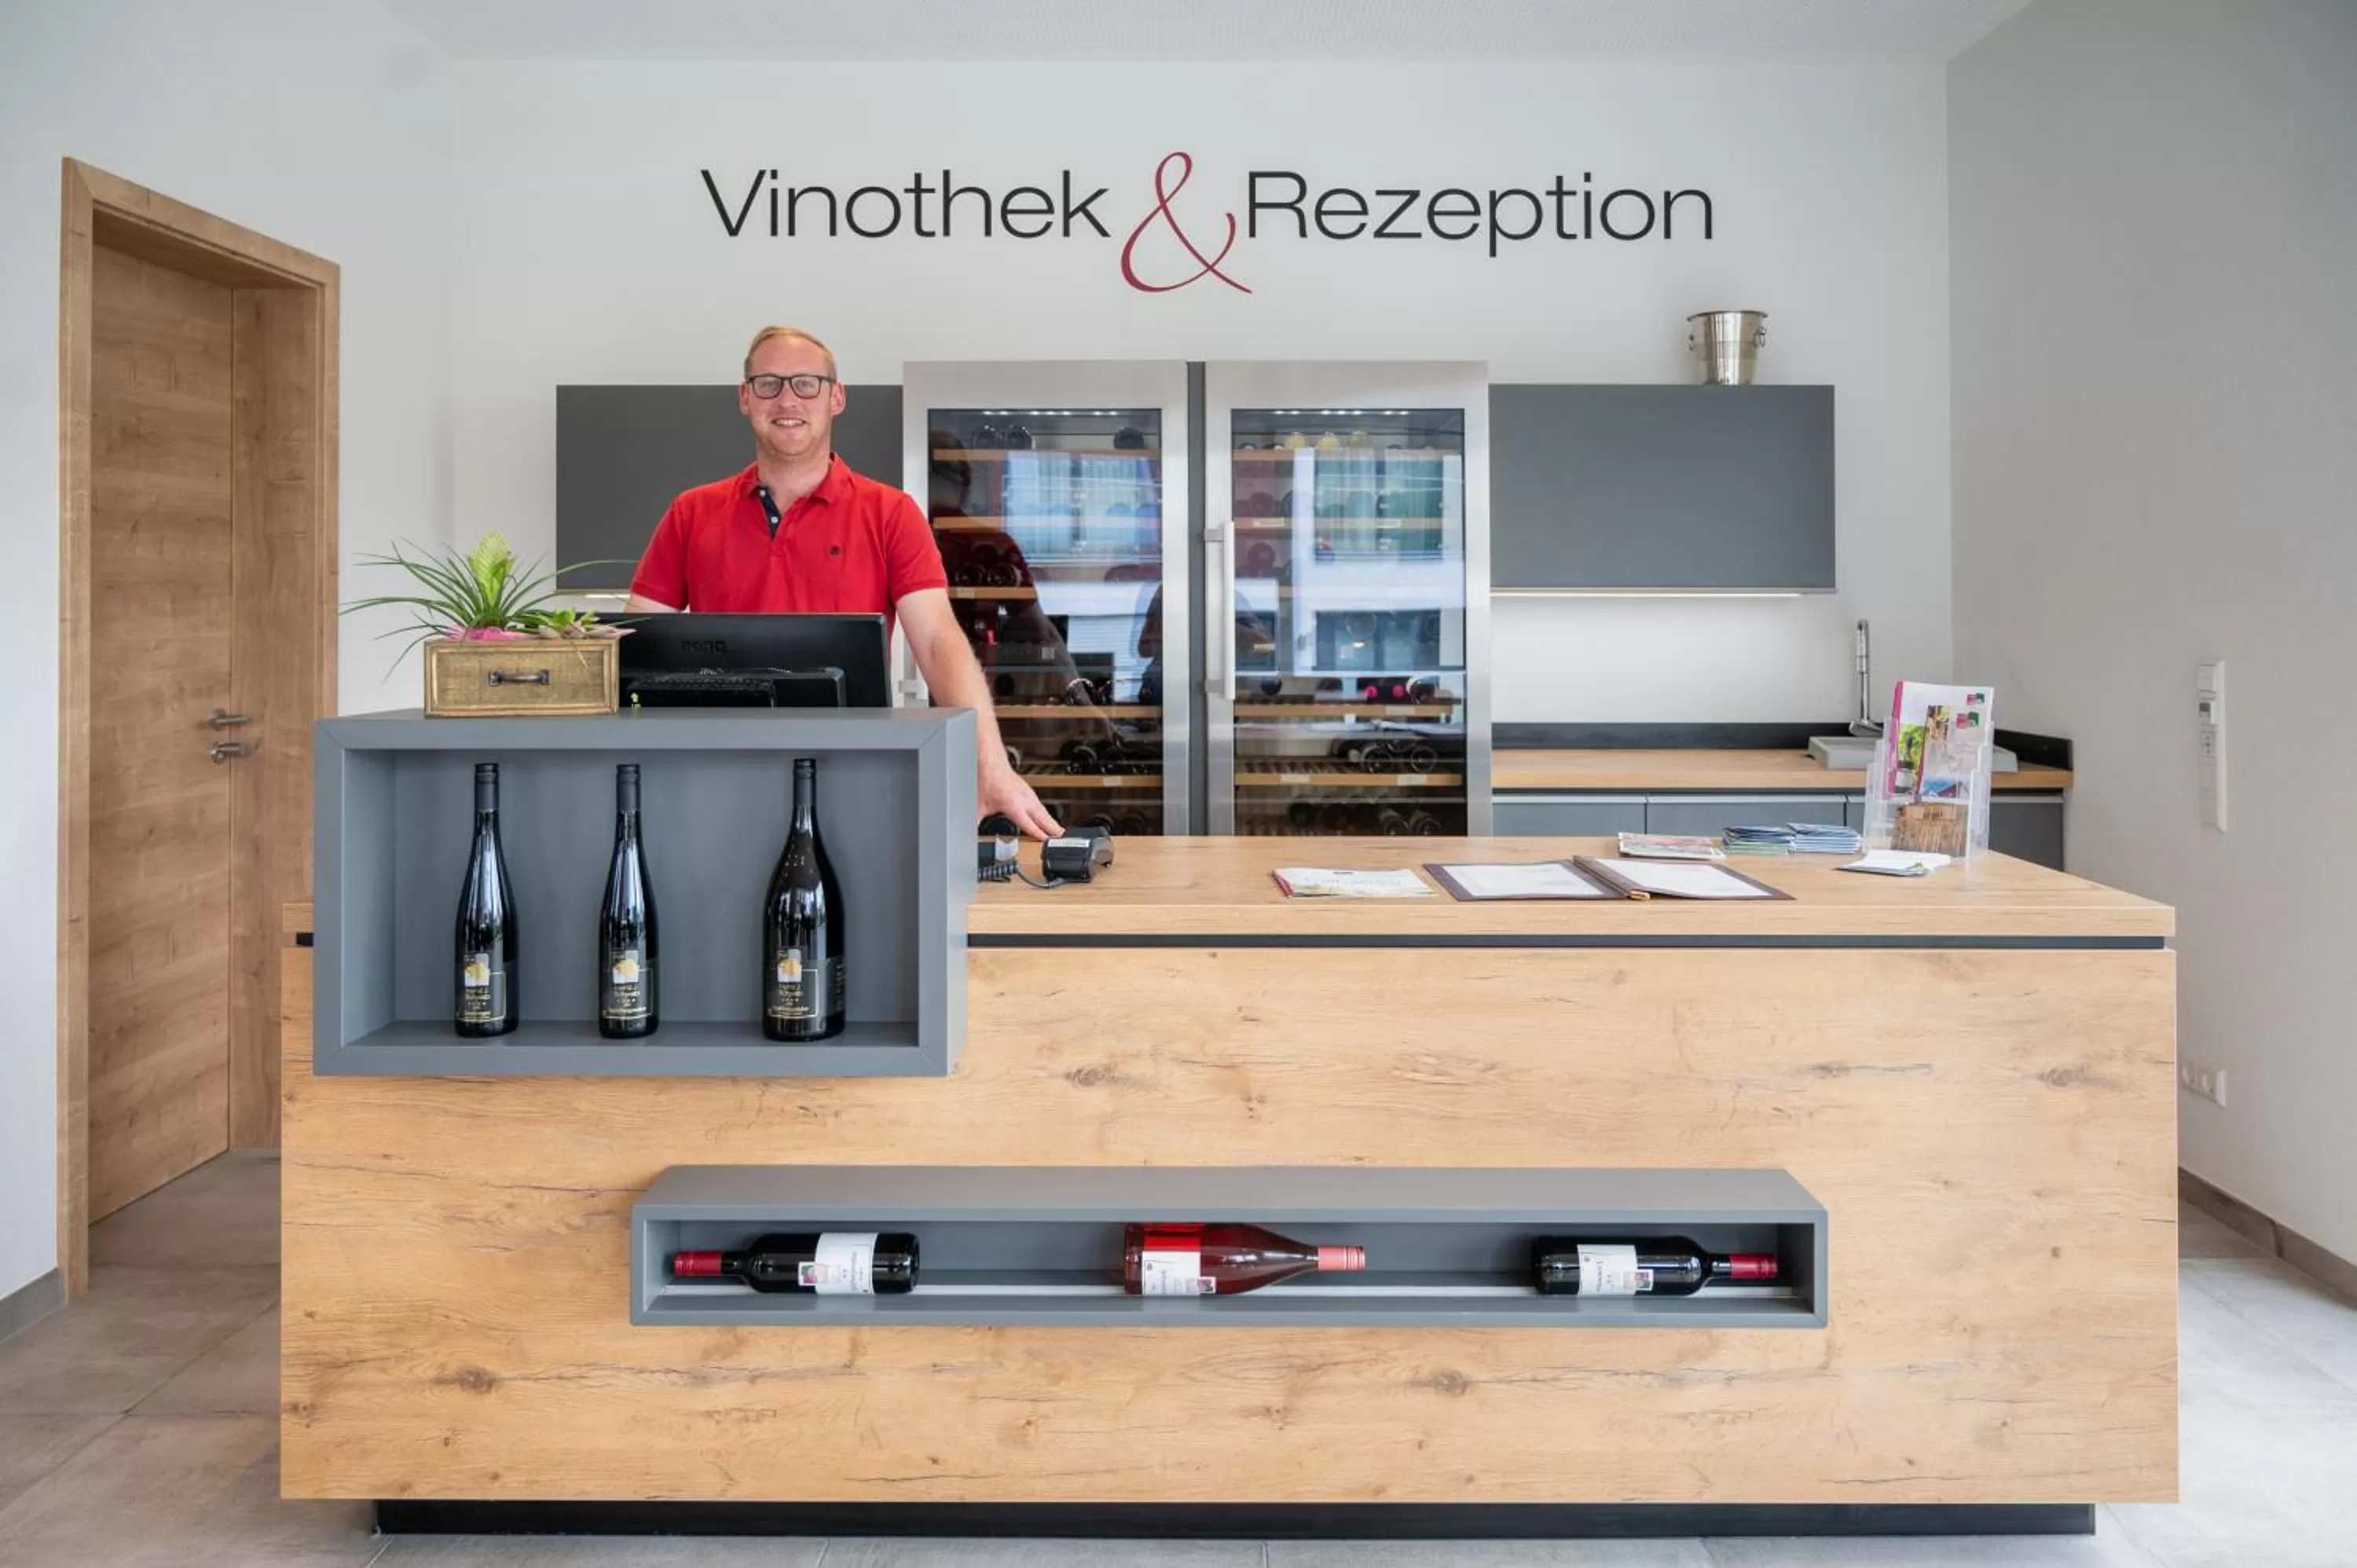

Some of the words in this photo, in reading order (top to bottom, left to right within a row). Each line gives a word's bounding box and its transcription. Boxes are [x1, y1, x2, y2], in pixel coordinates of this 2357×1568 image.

[700, 169, 1112, 238] Vinothek
[1120, 152, 1251, 293] &
[1248, 170, 1714, 258] Rezeption
